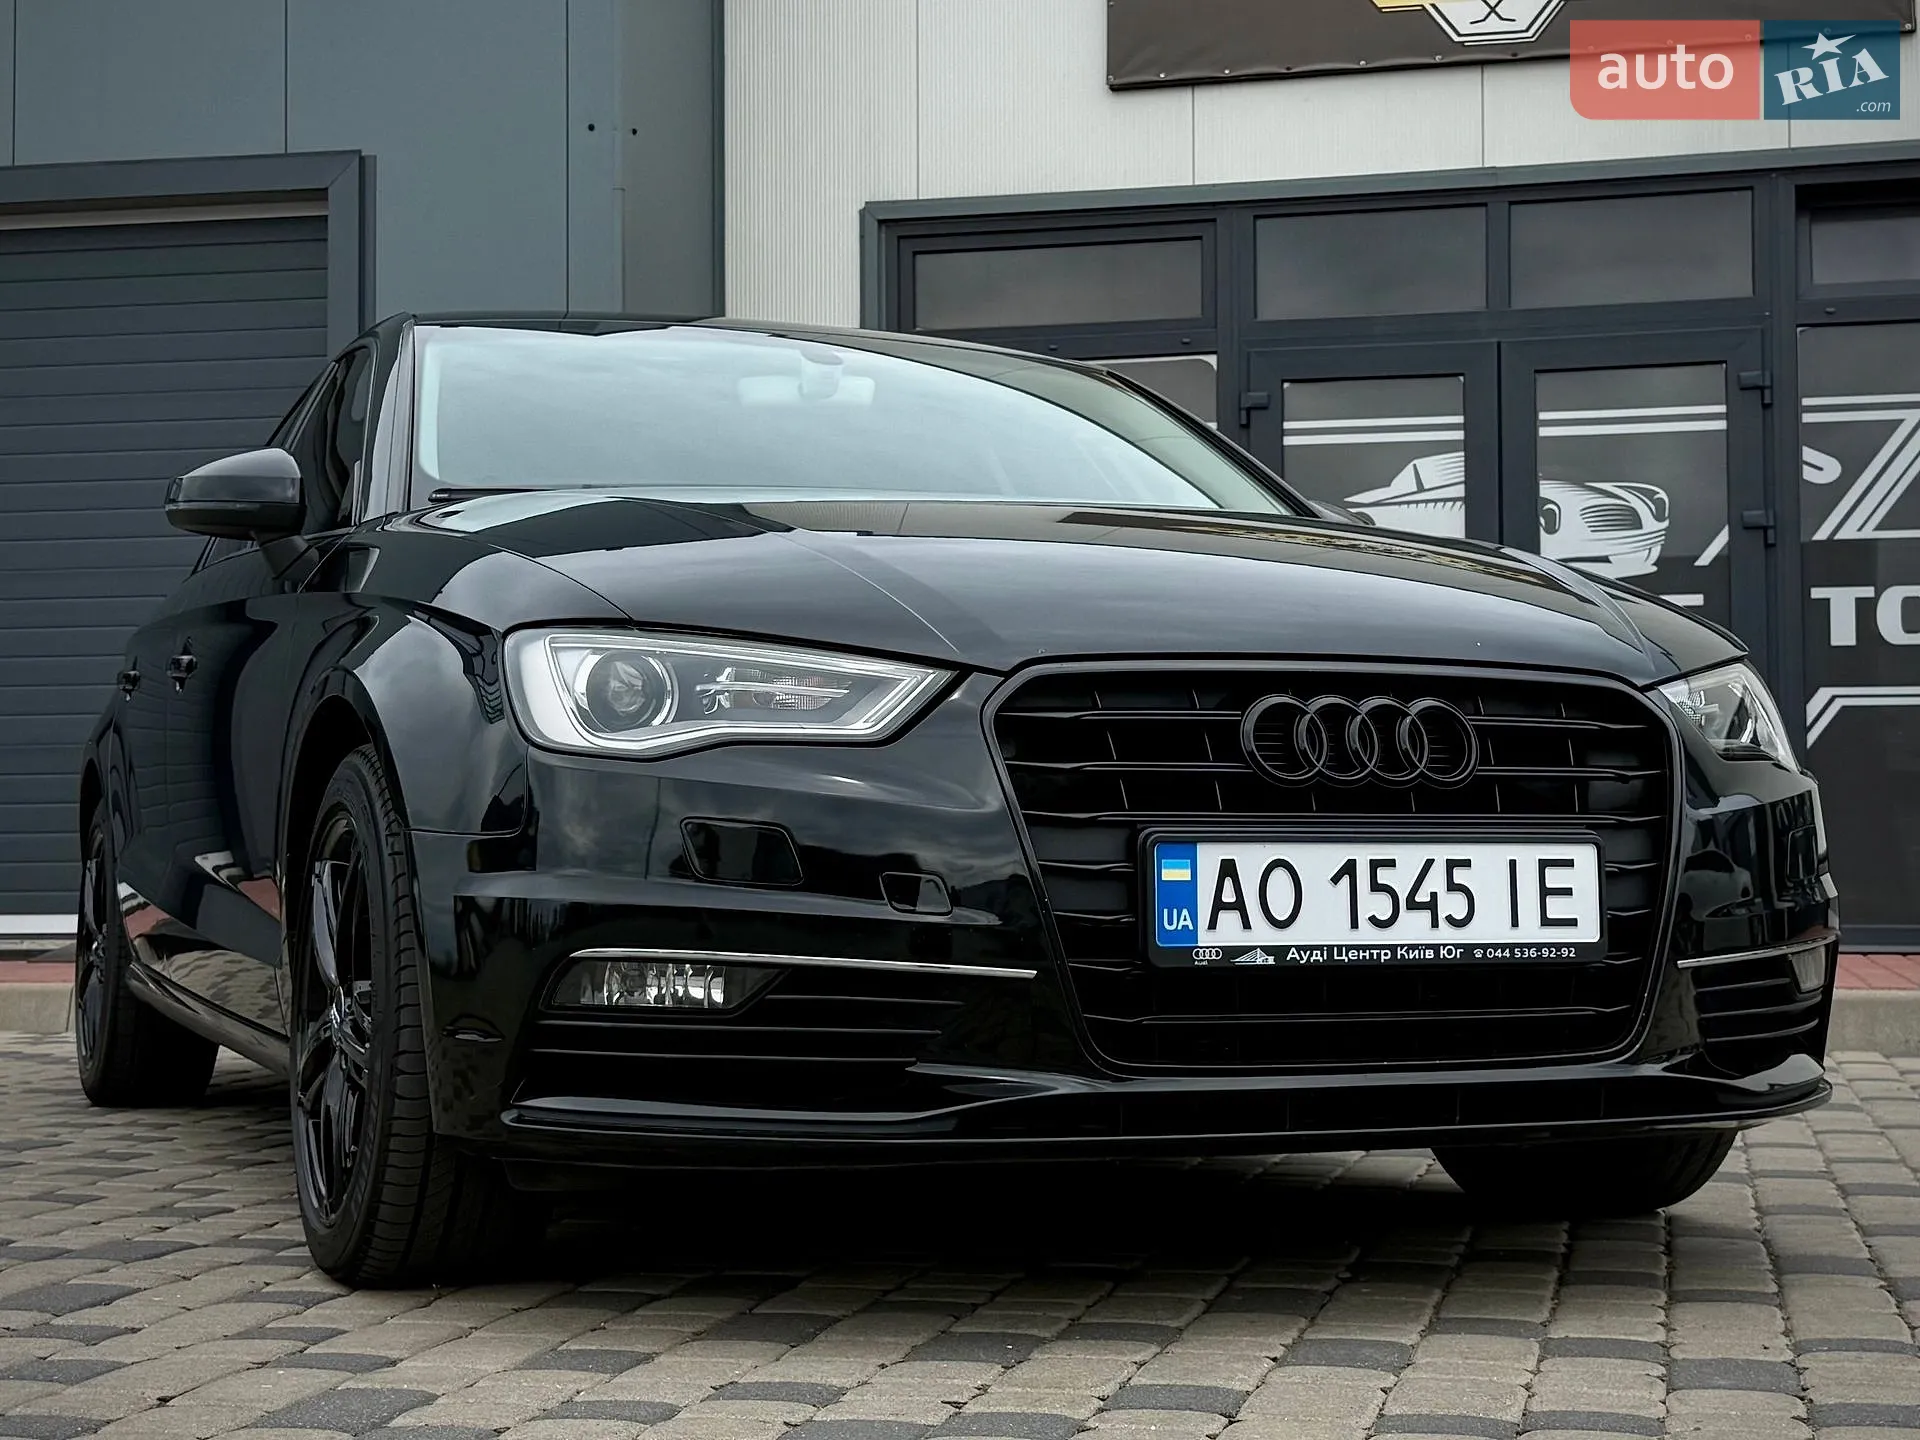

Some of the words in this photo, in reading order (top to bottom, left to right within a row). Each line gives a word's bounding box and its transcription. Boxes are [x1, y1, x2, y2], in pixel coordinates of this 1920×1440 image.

[1207, 858, 1303, 931] AO
[1329, 858, 1476, 930] 1545
[1509, 858, 1579, 929] IE
[1163, 908, 1194, 931] UA
[1286, 946, 1328, 964] Ауді
[1333, 947, 1392, 963] Центр
[1397, 945, 1435, 960] Київ
[1439, 945, 1465, 960] Юг
[1486, 948, 1511, 959] 044
[1514, 947, 1577, 959] 536-92-92
